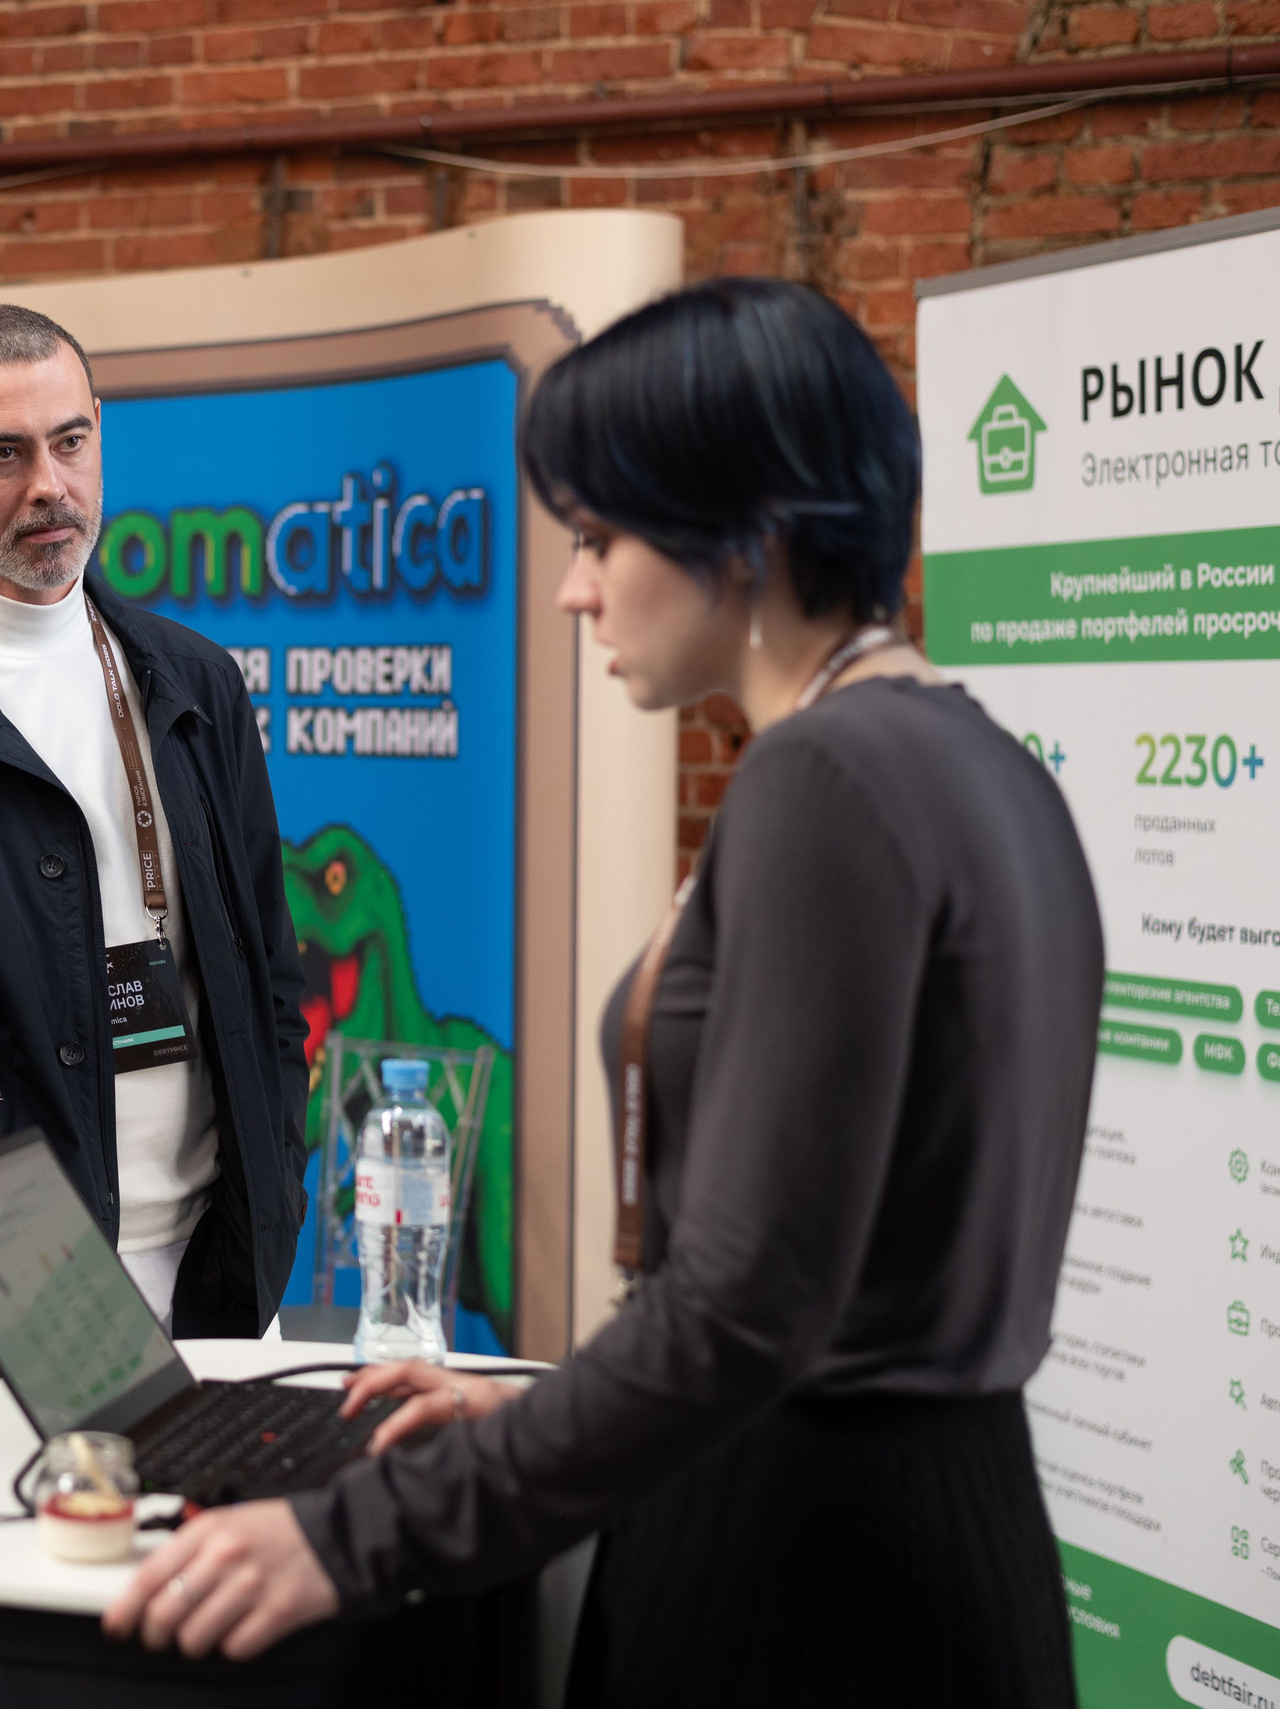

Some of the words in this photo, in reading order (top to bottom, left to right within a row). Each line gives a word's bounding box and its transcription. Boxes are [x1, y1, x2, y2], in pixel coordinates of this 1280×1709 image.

[1081, 339, 1265, 424] РЫНОК
[1081, 442, 1249, 488] Электронная
[1050, 563, 1175, 602] Крупнейший
[1180, 568, 1192, 590] в
[1197, 562, 1275, 589] России
[971, 621, 994, 644] по
[996, 618, 1078, 648] продаже
[1081, 607, 1188, 644] портфелей
[102, 644, 111, 667] 2025
[287, 645, 452, 694] ПРОВЕРКИ
[108, 669, 117, 692] TALK
[114, 693, 124, 717] DOLG
[287, 700, 458, 757] КОМПАНИЙ
[1135, 732, 1263, 788] 2230+
[1134, 814, 1216, 834] проданных
[1134, 848, 1175, 867] лотов
[1142, 913, 1182, 943] Кому
[1188, 917, 1235, 944] будет
[1240, 927, 1280, 947] выго
[108, 980, 143, 997] СЛАВ
[153, 1045, 188, 1056] DEBTPRICE
[1204, 1042, 1234, 1062] МФК
